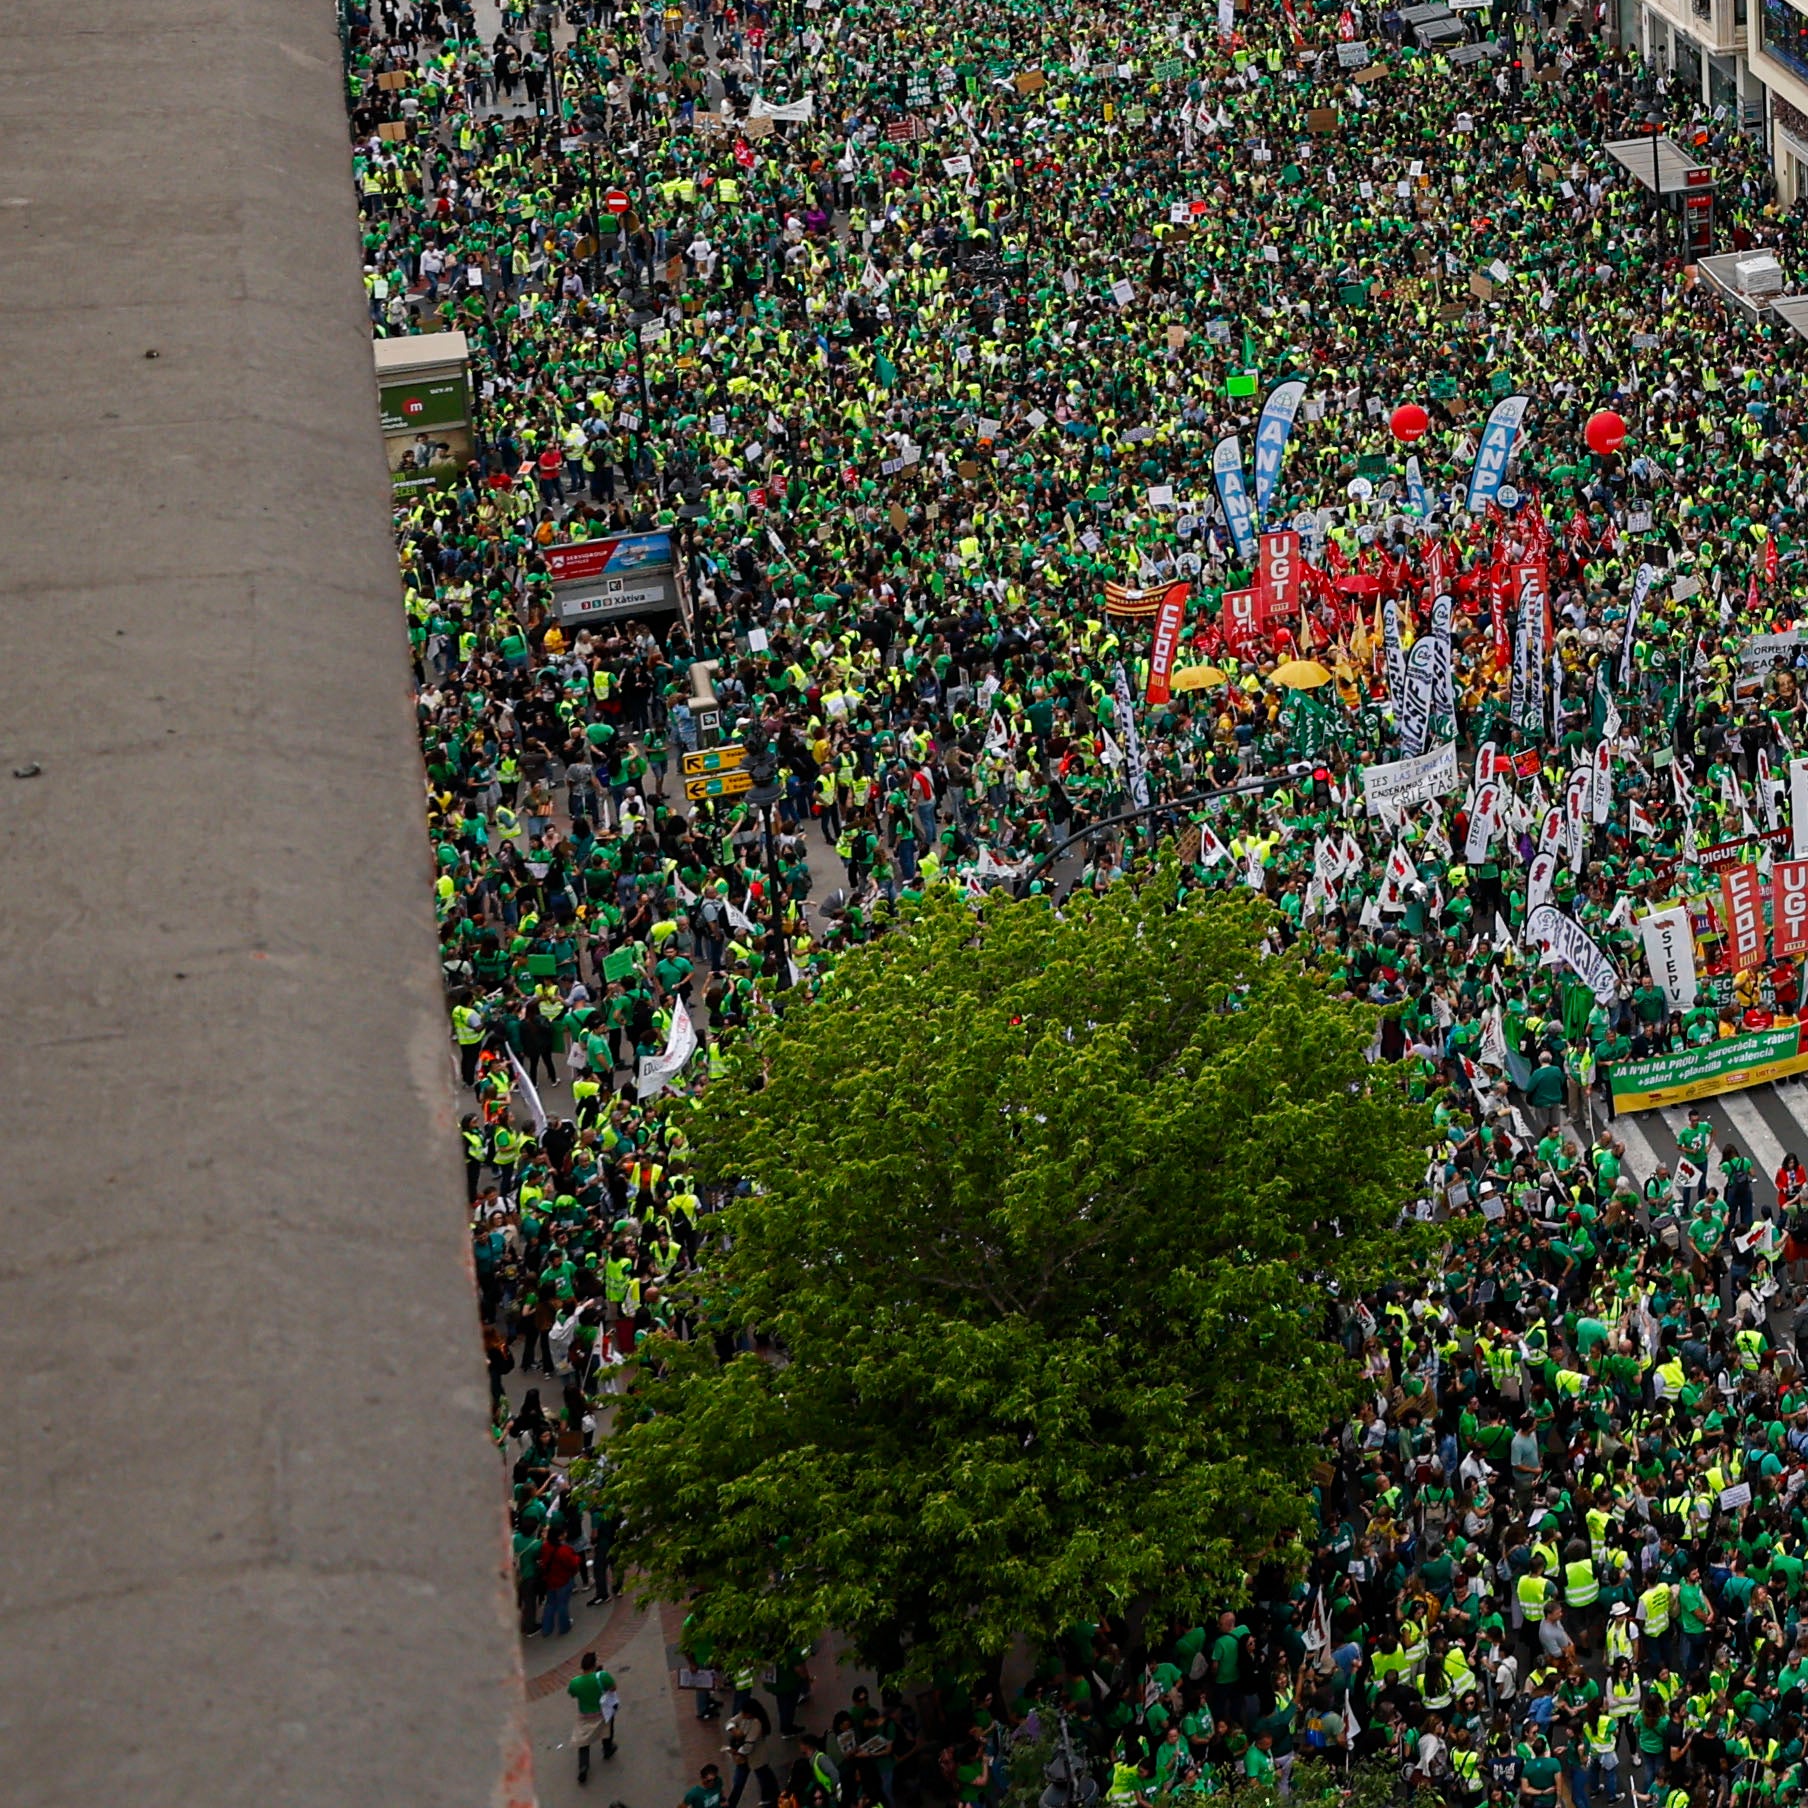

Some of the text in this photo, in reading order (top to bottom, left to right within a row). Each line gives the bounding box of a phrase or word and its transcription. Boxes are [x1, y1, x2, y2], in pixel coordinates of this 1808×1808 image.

[1469, 426, 1507, 512] ANPE
[1269, 536, 1290, 601] UGT
[614, 593, 646, 605] Xàtiva
[1152, 604, 1180, 674] CCOO
[1403, 679, 1426, 739] CSIF
[1392, 774, 1454, 806] GRIETAS
[1470, 815, 1483, 846] STEPV
[1700, 848, 1738, 865] DIGUE
[1729, 869, 1757, 954] CCOO
[1783, 866, 1807, 938] UGT
[1661, 930, 1680, 1001] STEPV
[1613, 1065, 1627, 1078] JA
[1629, 1062, 1650, 1075] N'HI
[1651, 1060, 1666, 1072] HA
[1637, 1047, 1774, 1087] +salari +plantilla +valencià
